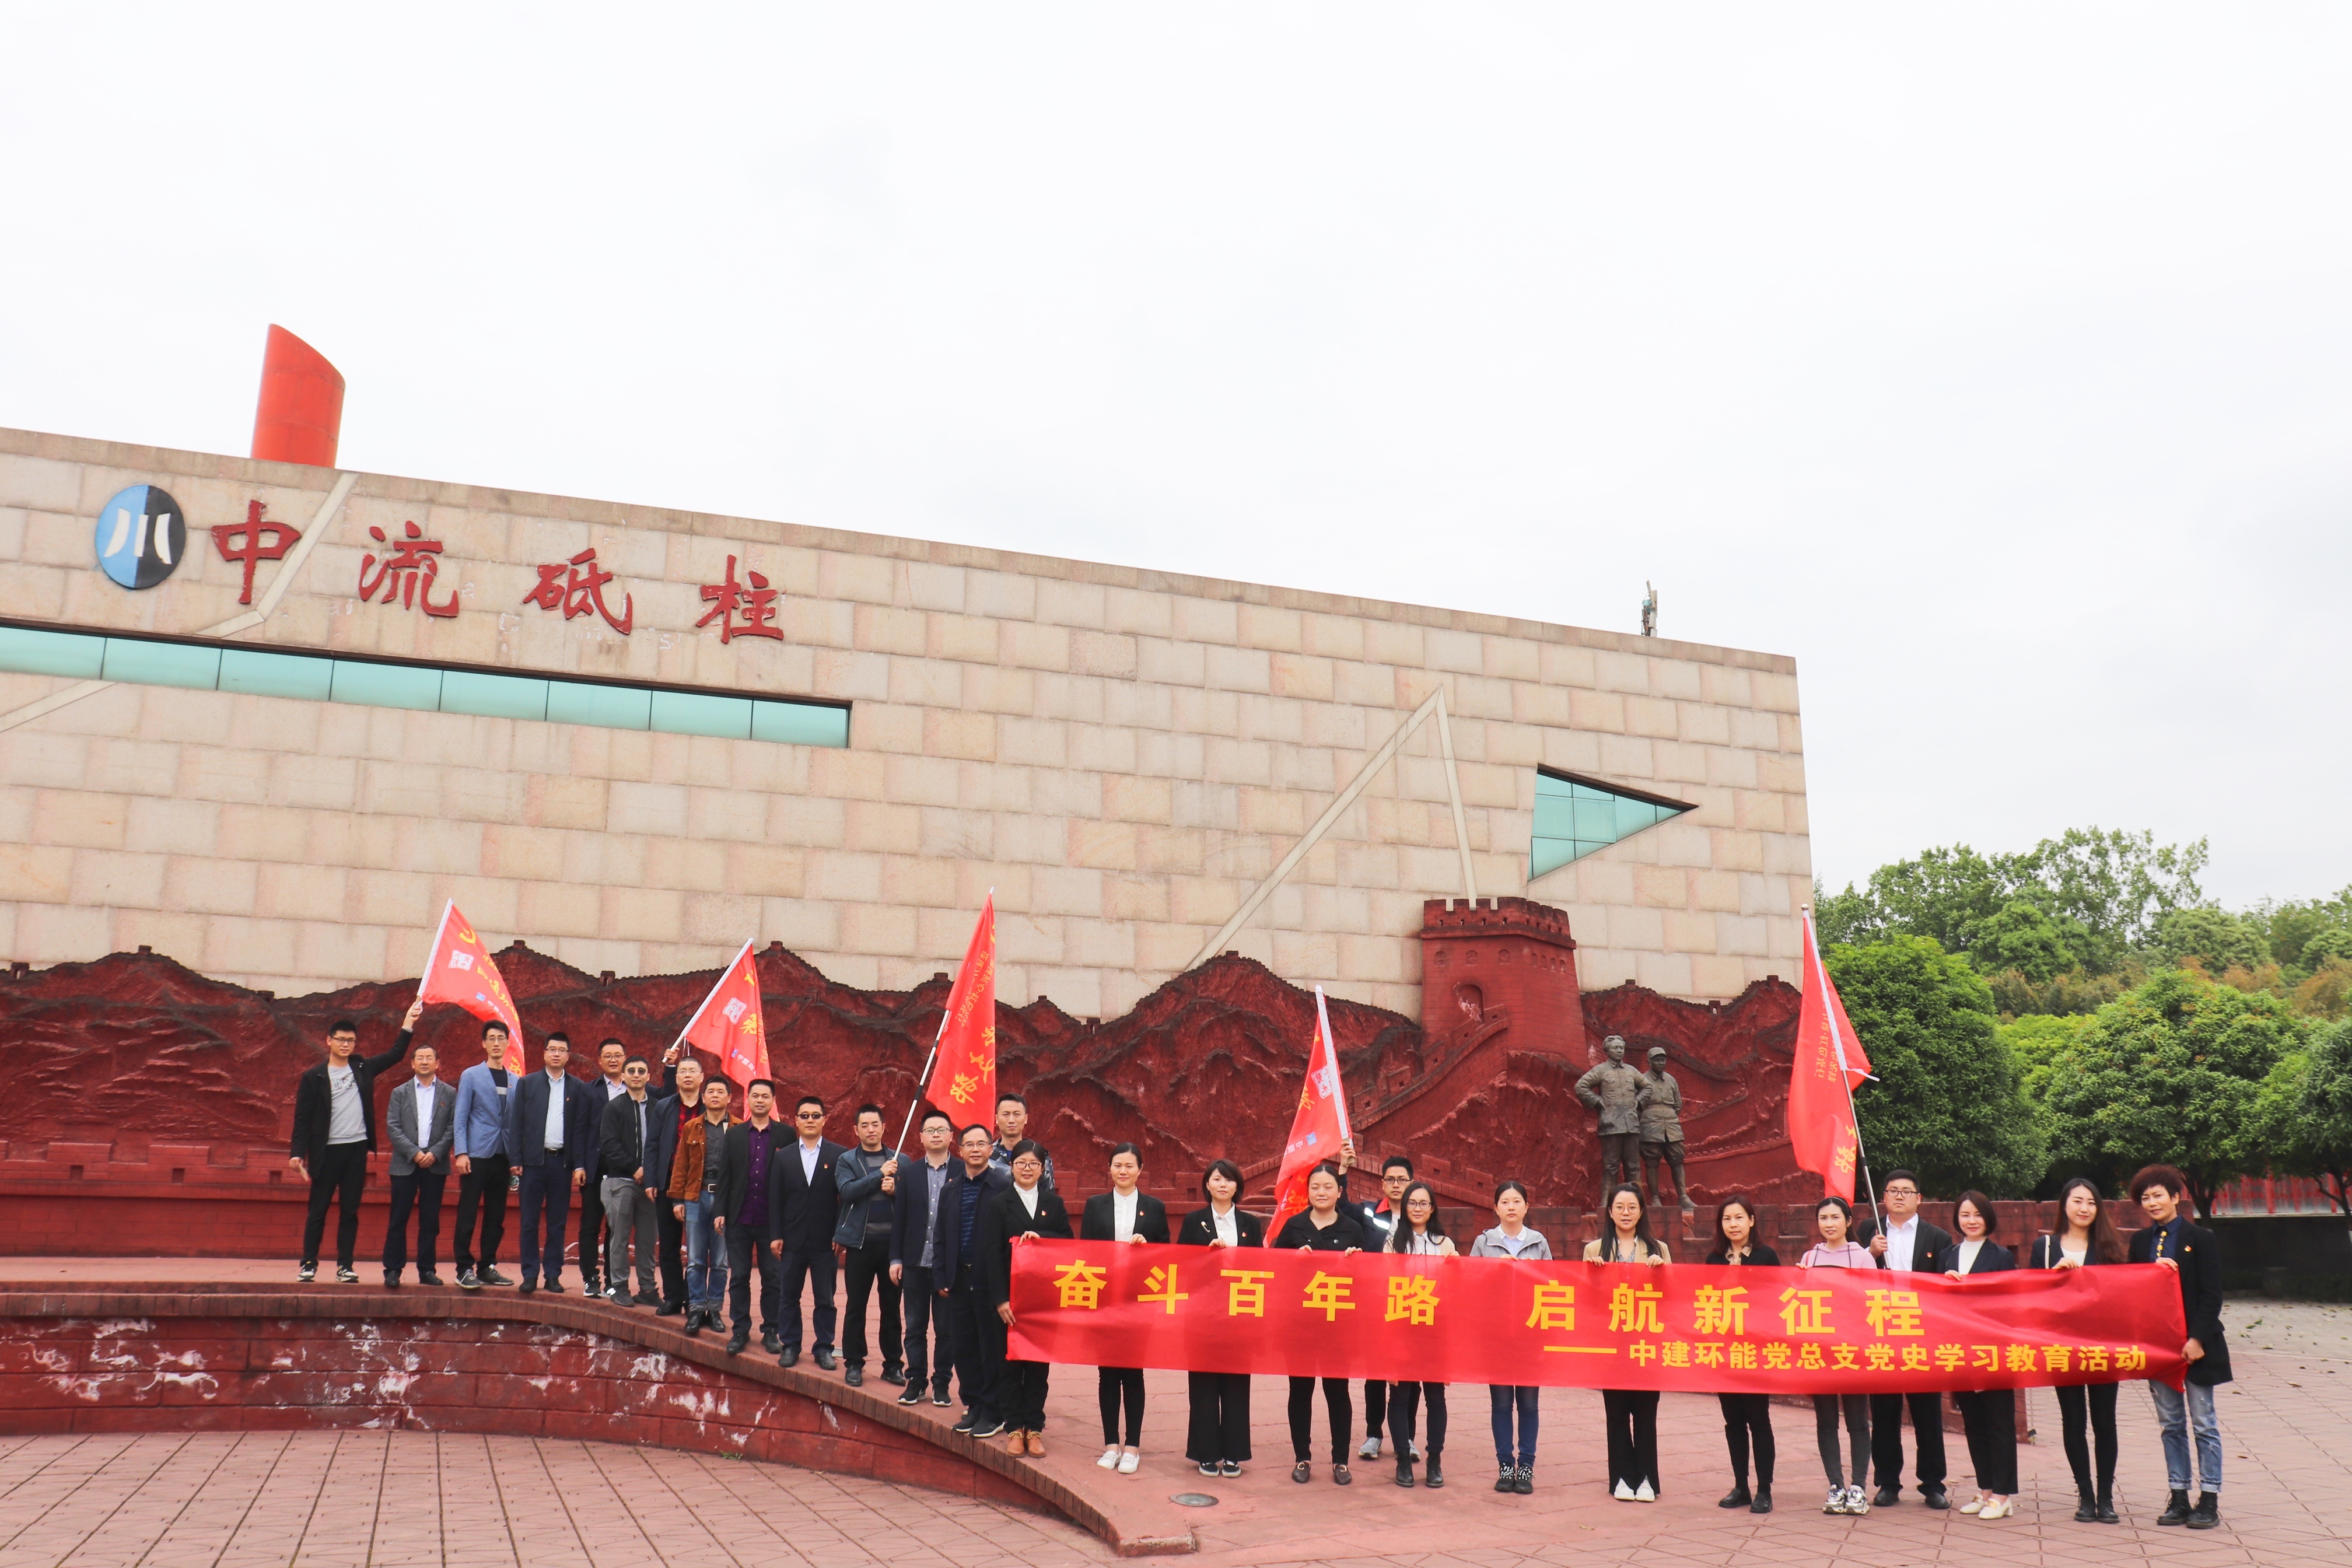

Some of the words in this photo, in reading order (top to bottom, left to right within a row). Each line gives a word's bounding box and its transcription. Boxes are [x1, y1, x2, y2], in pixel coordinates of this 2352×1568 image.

[211, 500, 785, 643] 中流砥柱
[1052, 1259, 1441, 1326] 奋斗百年路
[1525, 1279, 1925, 1338] 启航新征程
